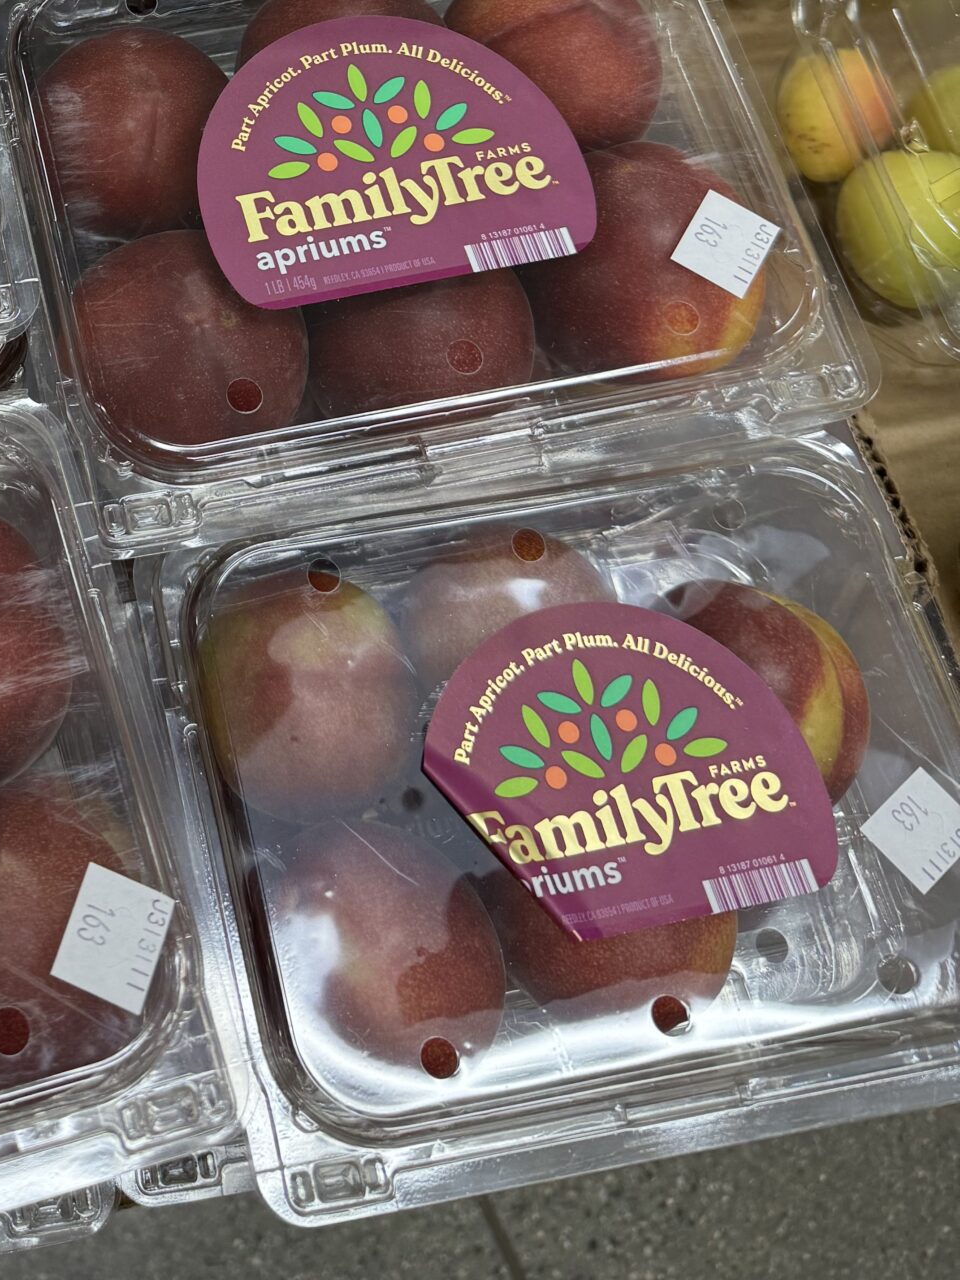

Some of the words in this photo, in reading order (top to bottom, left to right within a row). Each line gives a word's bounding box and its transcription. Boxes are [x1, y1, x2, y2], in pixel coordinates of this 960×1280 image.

[231, 117, 255, 152] Part
[252, 67, 302, 117] Apricot.
[299, 47, 338, 69] Part
[341, 42, 392, 56] Plum.
[397, 43, 423, 58] All
[427, 49, 504, 105] Delicious.
[476, 142, 531, 161] FARMS
[235, 156, 552, 242] FamilyTree
[256, 228, 387, 274] apriums
[488, 230, 512, 239] 13187
[515, 226, 538, 234] 01061
[694, 217, 728, 248] 163
[454, 720, 477, 765] Part
[470, 662, 524, 720] Apricot.
[521, 637, 562, 666] Part
[562, 633, 618, 649] Plum.
[622, 633, 649, 653] All
[653, 643, 737, 710] Delicious.
[709, 755, 767, 777] FARMS
[891, 795, 929, 832] 163
[522, 859, 622, 898] riums
[726, 860, 751, 873] 13187
[753, 856, 777, 868] 01061
[76, 904, 116, 946] 163
